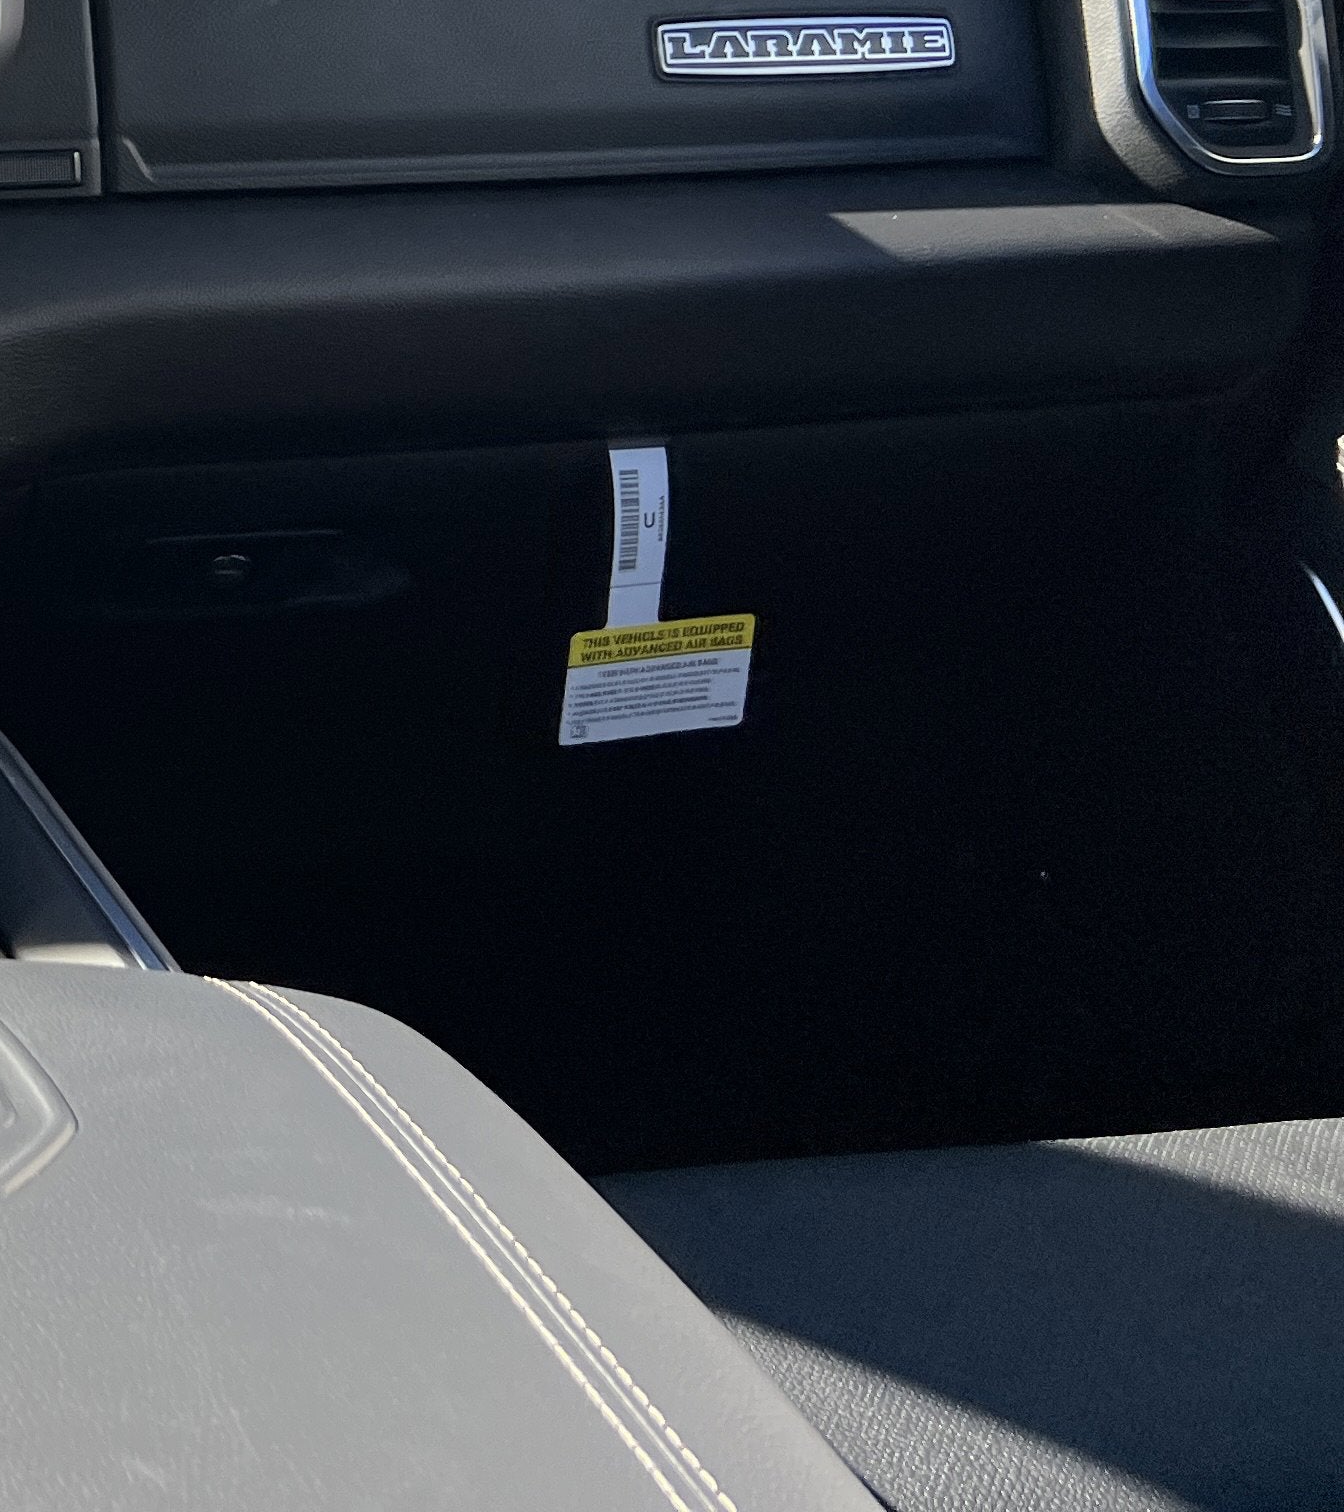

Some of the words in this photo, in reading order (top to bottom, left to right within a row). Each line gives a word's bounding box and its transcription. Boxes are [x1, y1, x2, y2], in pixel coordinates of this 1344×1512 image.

[663, 27, 951, 65] LARAMIE
[581, 649, 612, 662] WITH
[615, 640, 683, 658] ADVANCED
[686, 638, 707, 649] AIR
[709, 634, 744, 647] BAGS
[583, 635, 610, 648] THIS
[613, 630, 664, 645] VEHICLE
[683, 622, 745, 637] EQUIPPED
